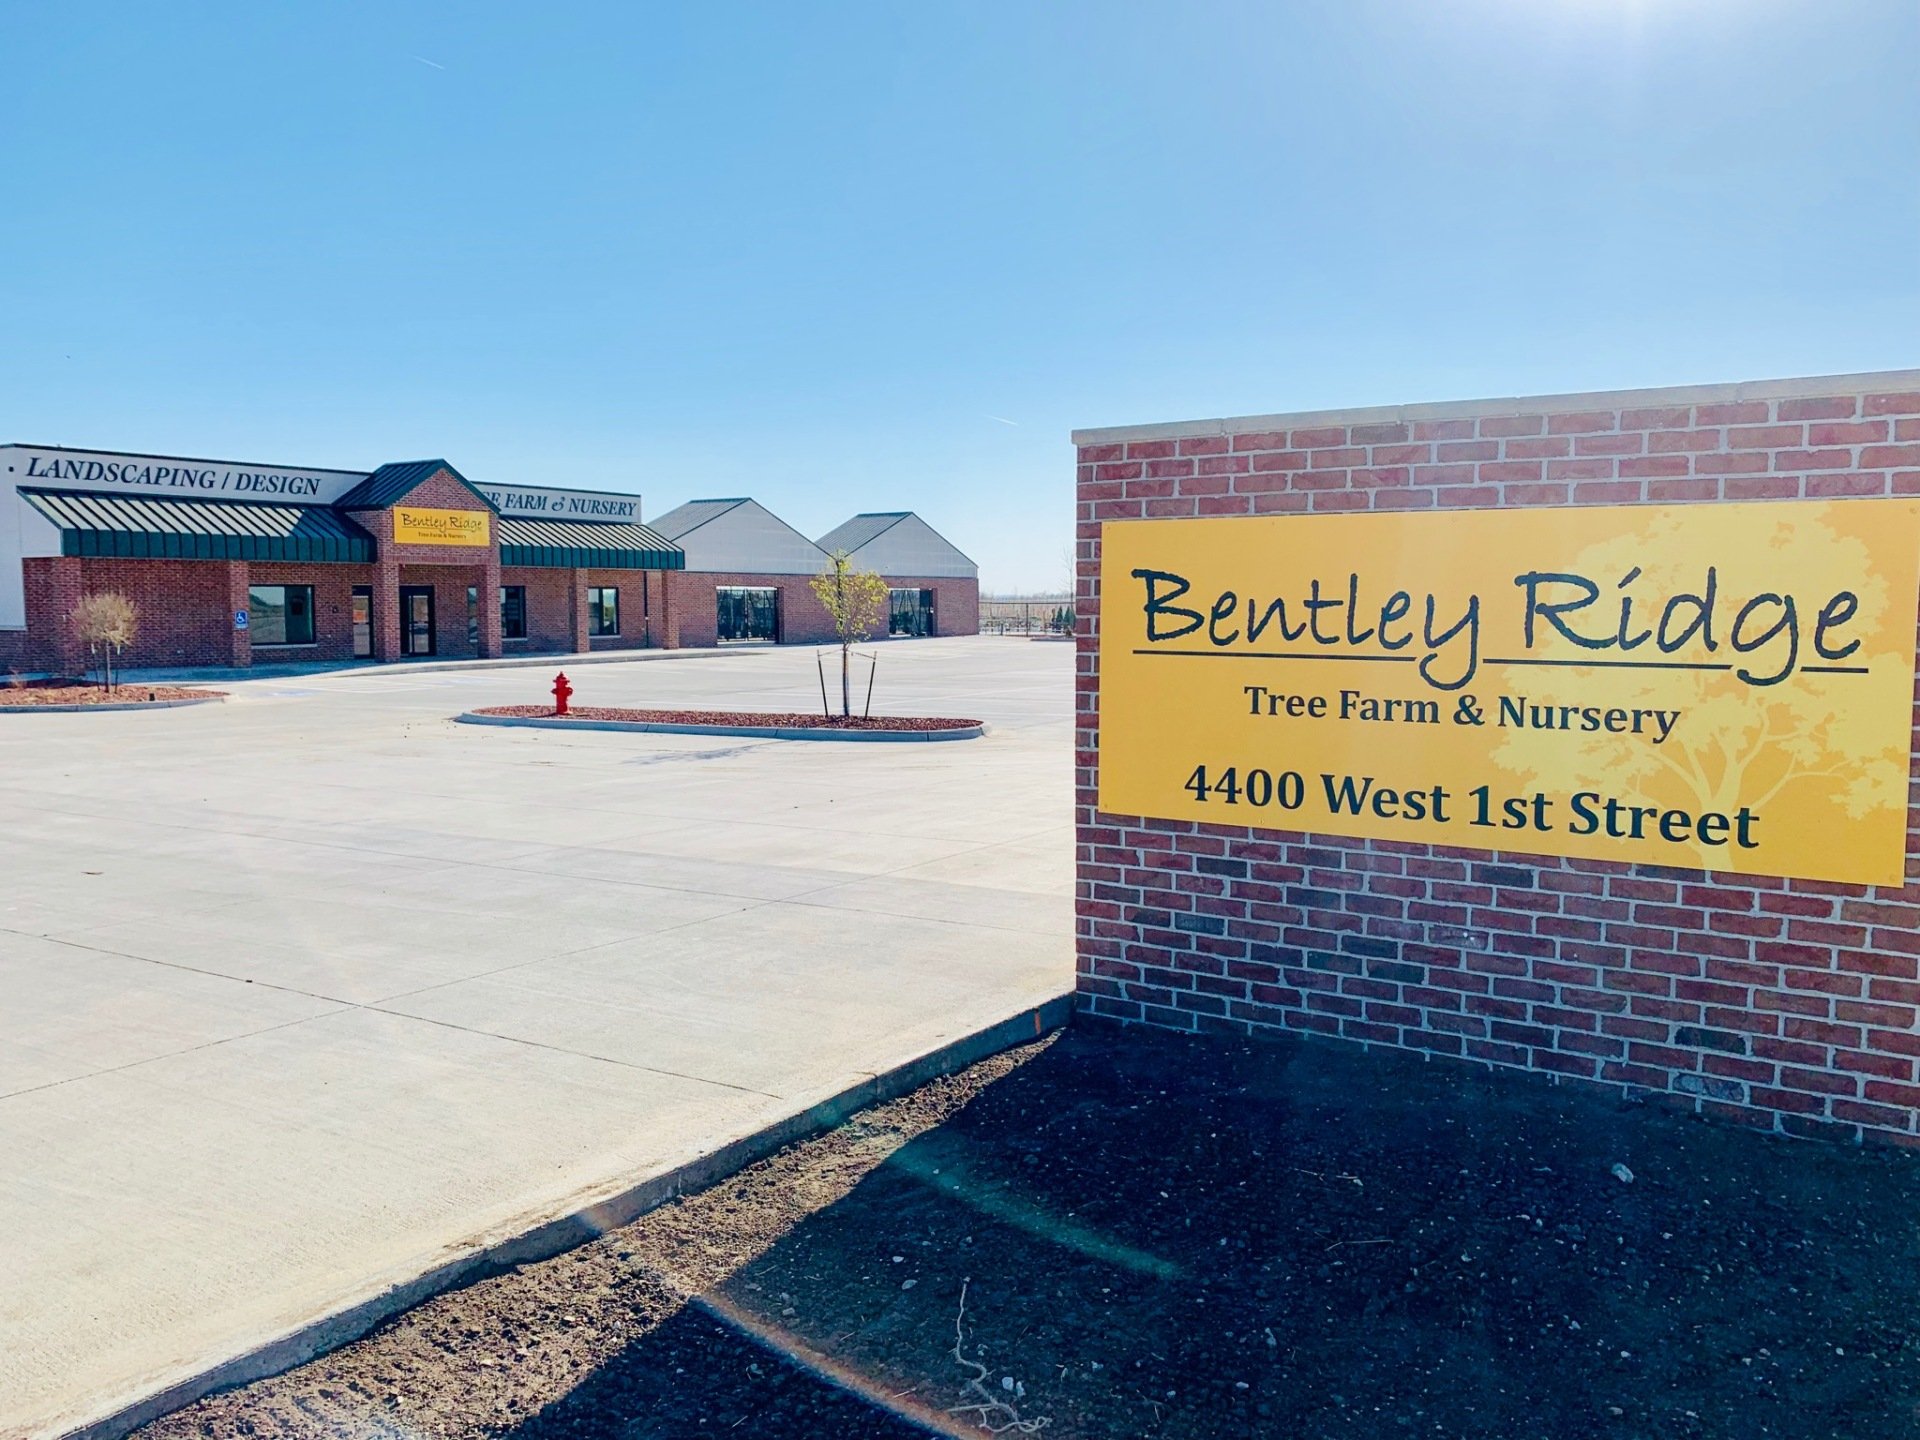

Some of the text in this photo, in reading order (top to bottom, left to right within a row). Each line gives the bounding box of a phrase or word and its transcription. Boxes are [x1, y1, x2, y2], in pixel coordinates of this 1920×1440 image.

[26, 457, 320, 495] LANDSCAPING / DESIGN
[401, 513, 482, 533] Bentley Ridge
[504, 493, 548, 511] FARM
[552, 496, 566, 512] &
[568, 498, 637, 516] NURSERY
[1131, 567, 1861, 690] Bentley Ridge
[1244, 686, 1681, 744] Tree Farm & Nursery
[1184, 765, 1760, 849] 4400 West 1st Street
